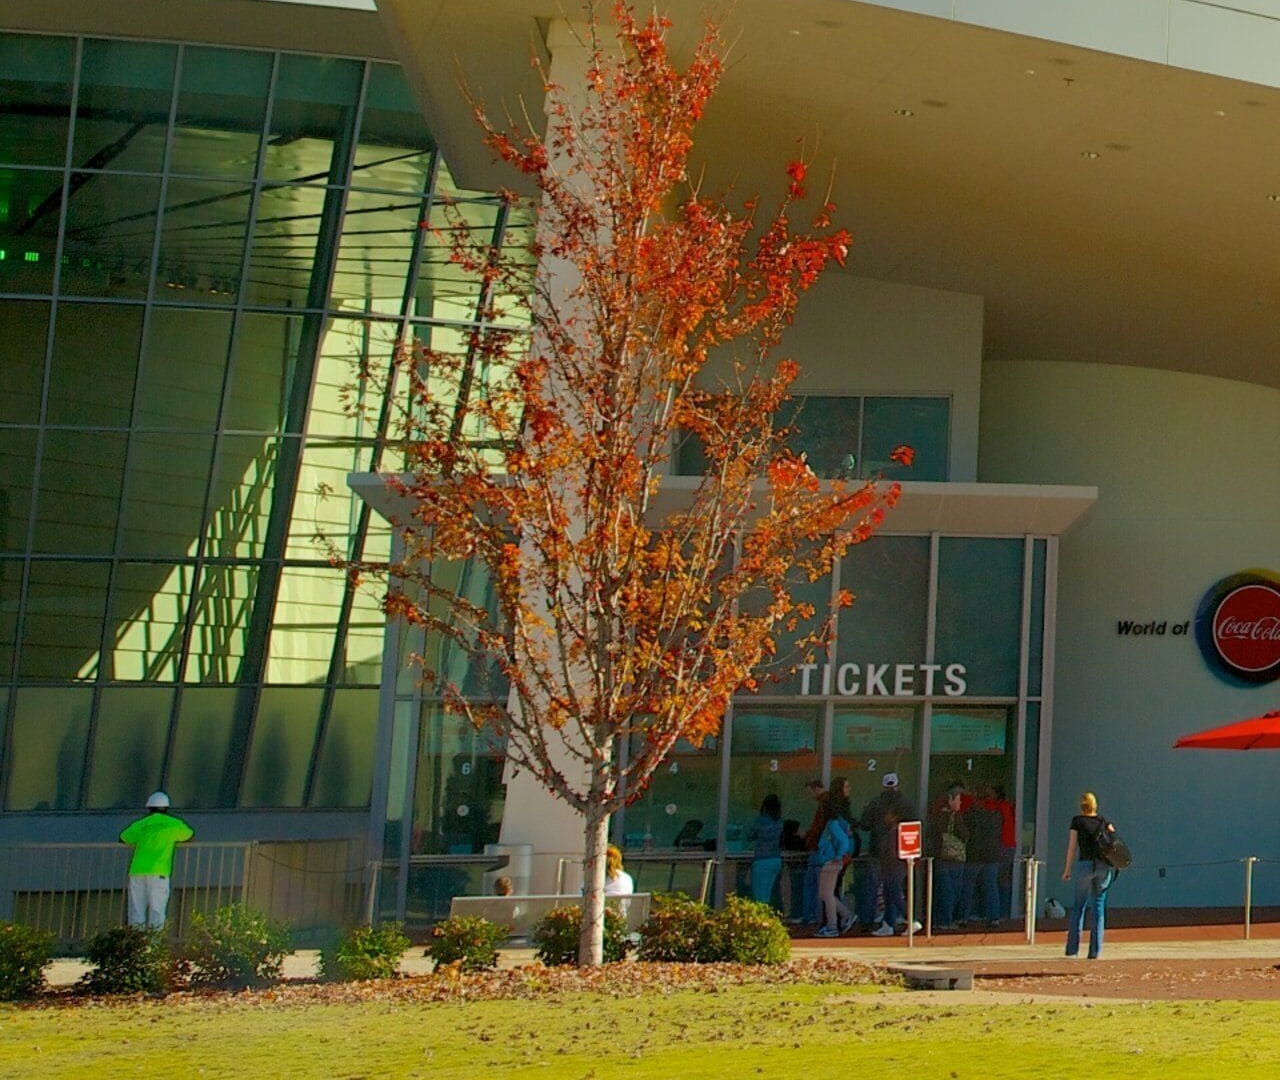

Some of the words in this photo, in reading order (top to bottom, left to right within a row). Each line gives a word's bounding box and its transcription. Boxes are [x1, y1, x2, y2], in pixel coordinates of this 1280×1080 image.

[1117, 621, 1166, 636] World
[1172, 620, 1190, 636] of
[798, 663, 967, 696] TICKETS
[462, 762, 471, 776] 6
[669, 762, 679, 775] 4
[770, 759, 779, 772] 3
[868, 758, 877, 771] 2
[966, 758, 973, 771] 1
